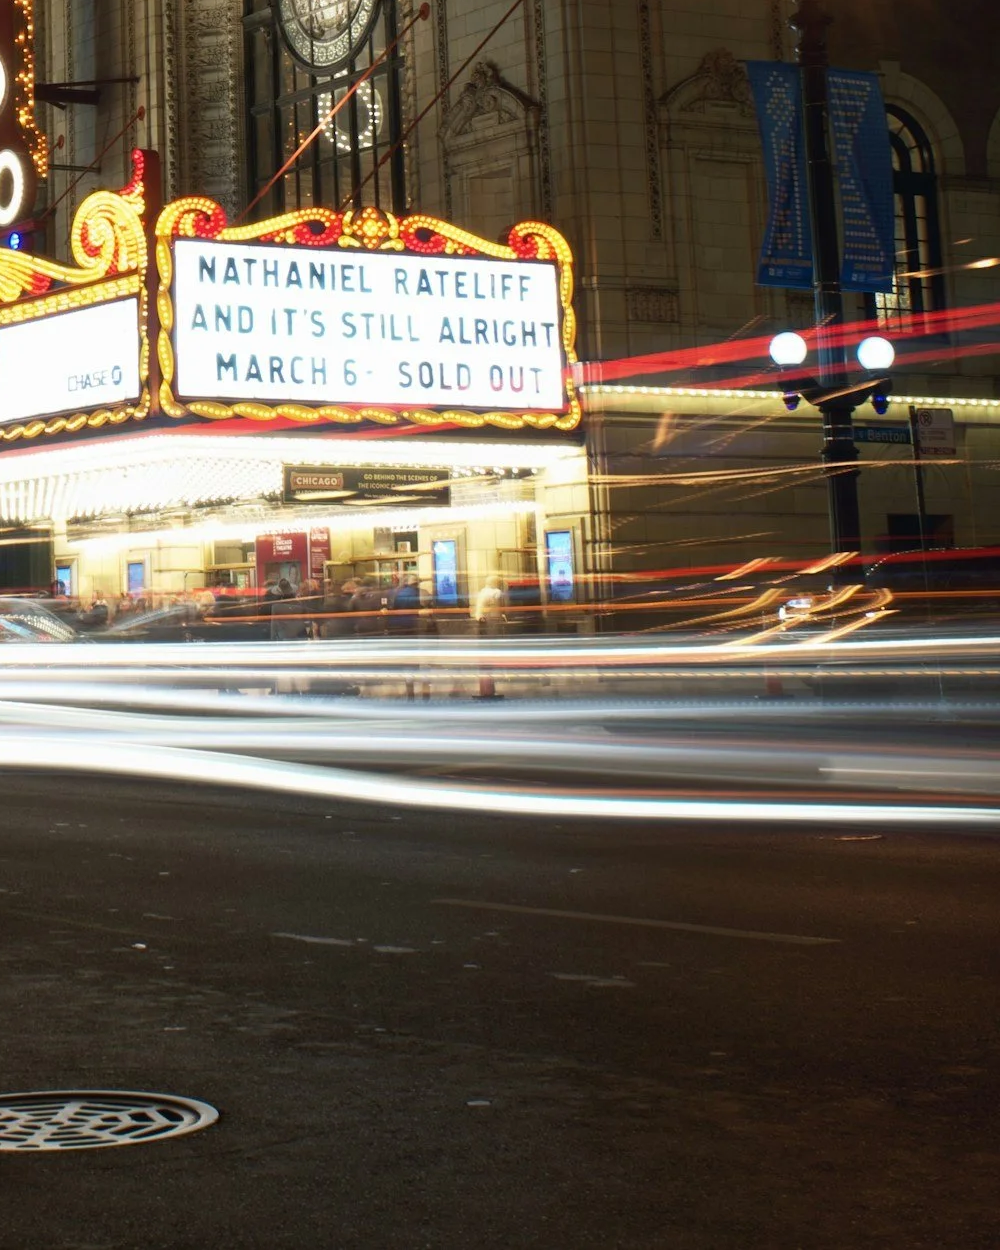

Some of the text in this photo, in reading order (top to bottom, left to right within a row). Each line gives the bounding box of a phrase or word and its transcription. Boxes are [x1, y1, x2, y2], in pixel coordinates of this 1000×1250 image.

[199, 255, 532, 301] NATHANIEL RATELIFF
[191, 303, 556, 348] AND IT'S STILL ALRIGHT
[68, 370, 109, 392] CHASE
[216, 352, 327, 386] MARCH
[399, 361, 471, 390] SOLD
[490, 365, 543, 394] OUT
[867, 429, 907, 442] Benton
[296, 477, 338, 486] CHICAGO
